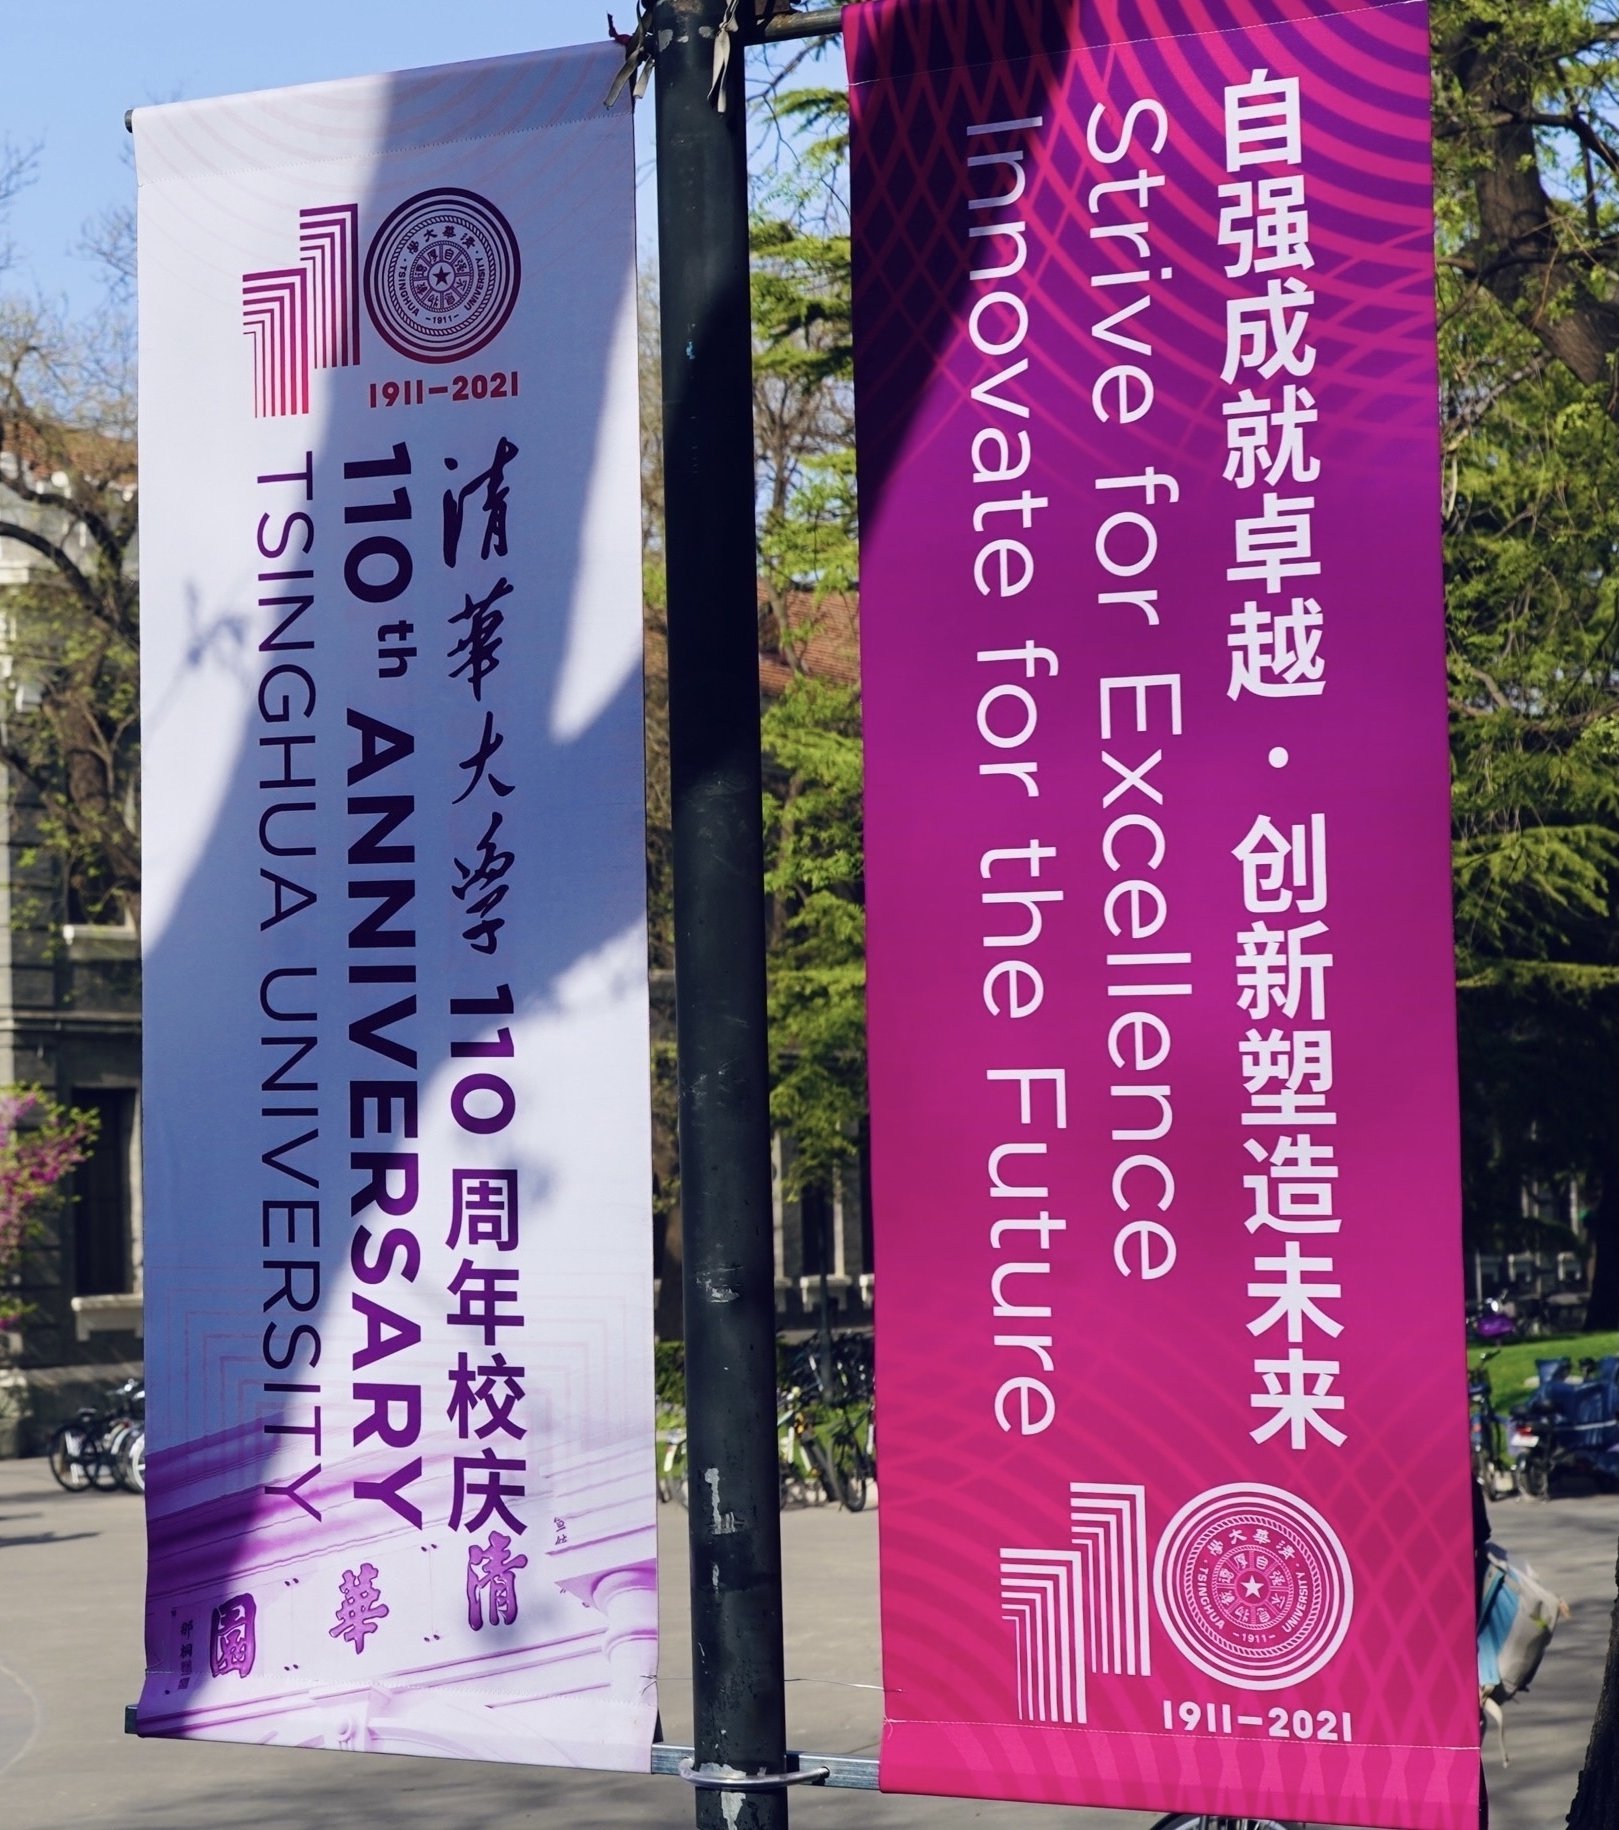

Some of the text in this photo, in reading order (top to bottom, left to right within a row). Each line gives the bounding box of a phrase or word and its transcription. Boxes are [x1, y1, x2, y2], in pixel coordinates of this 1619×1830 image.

[398, 265, 421, 317] TSINGHUA
[463, 257, 486, 311] UNIVERSITY
[966, 116, 1067, 1435] Innovate for the Future
[1086, 98, 1193, 1280] Strive for Excellence
[256, 450, 322, 1523] TSINGHUA UNIVERSITY
[346, 707, 423, 1531] ANNIVERSARY
[1197, 1567, 1225, 1630] TSINGHUA
[1281, 1571, 1308, 1633] UNIVERSITY
